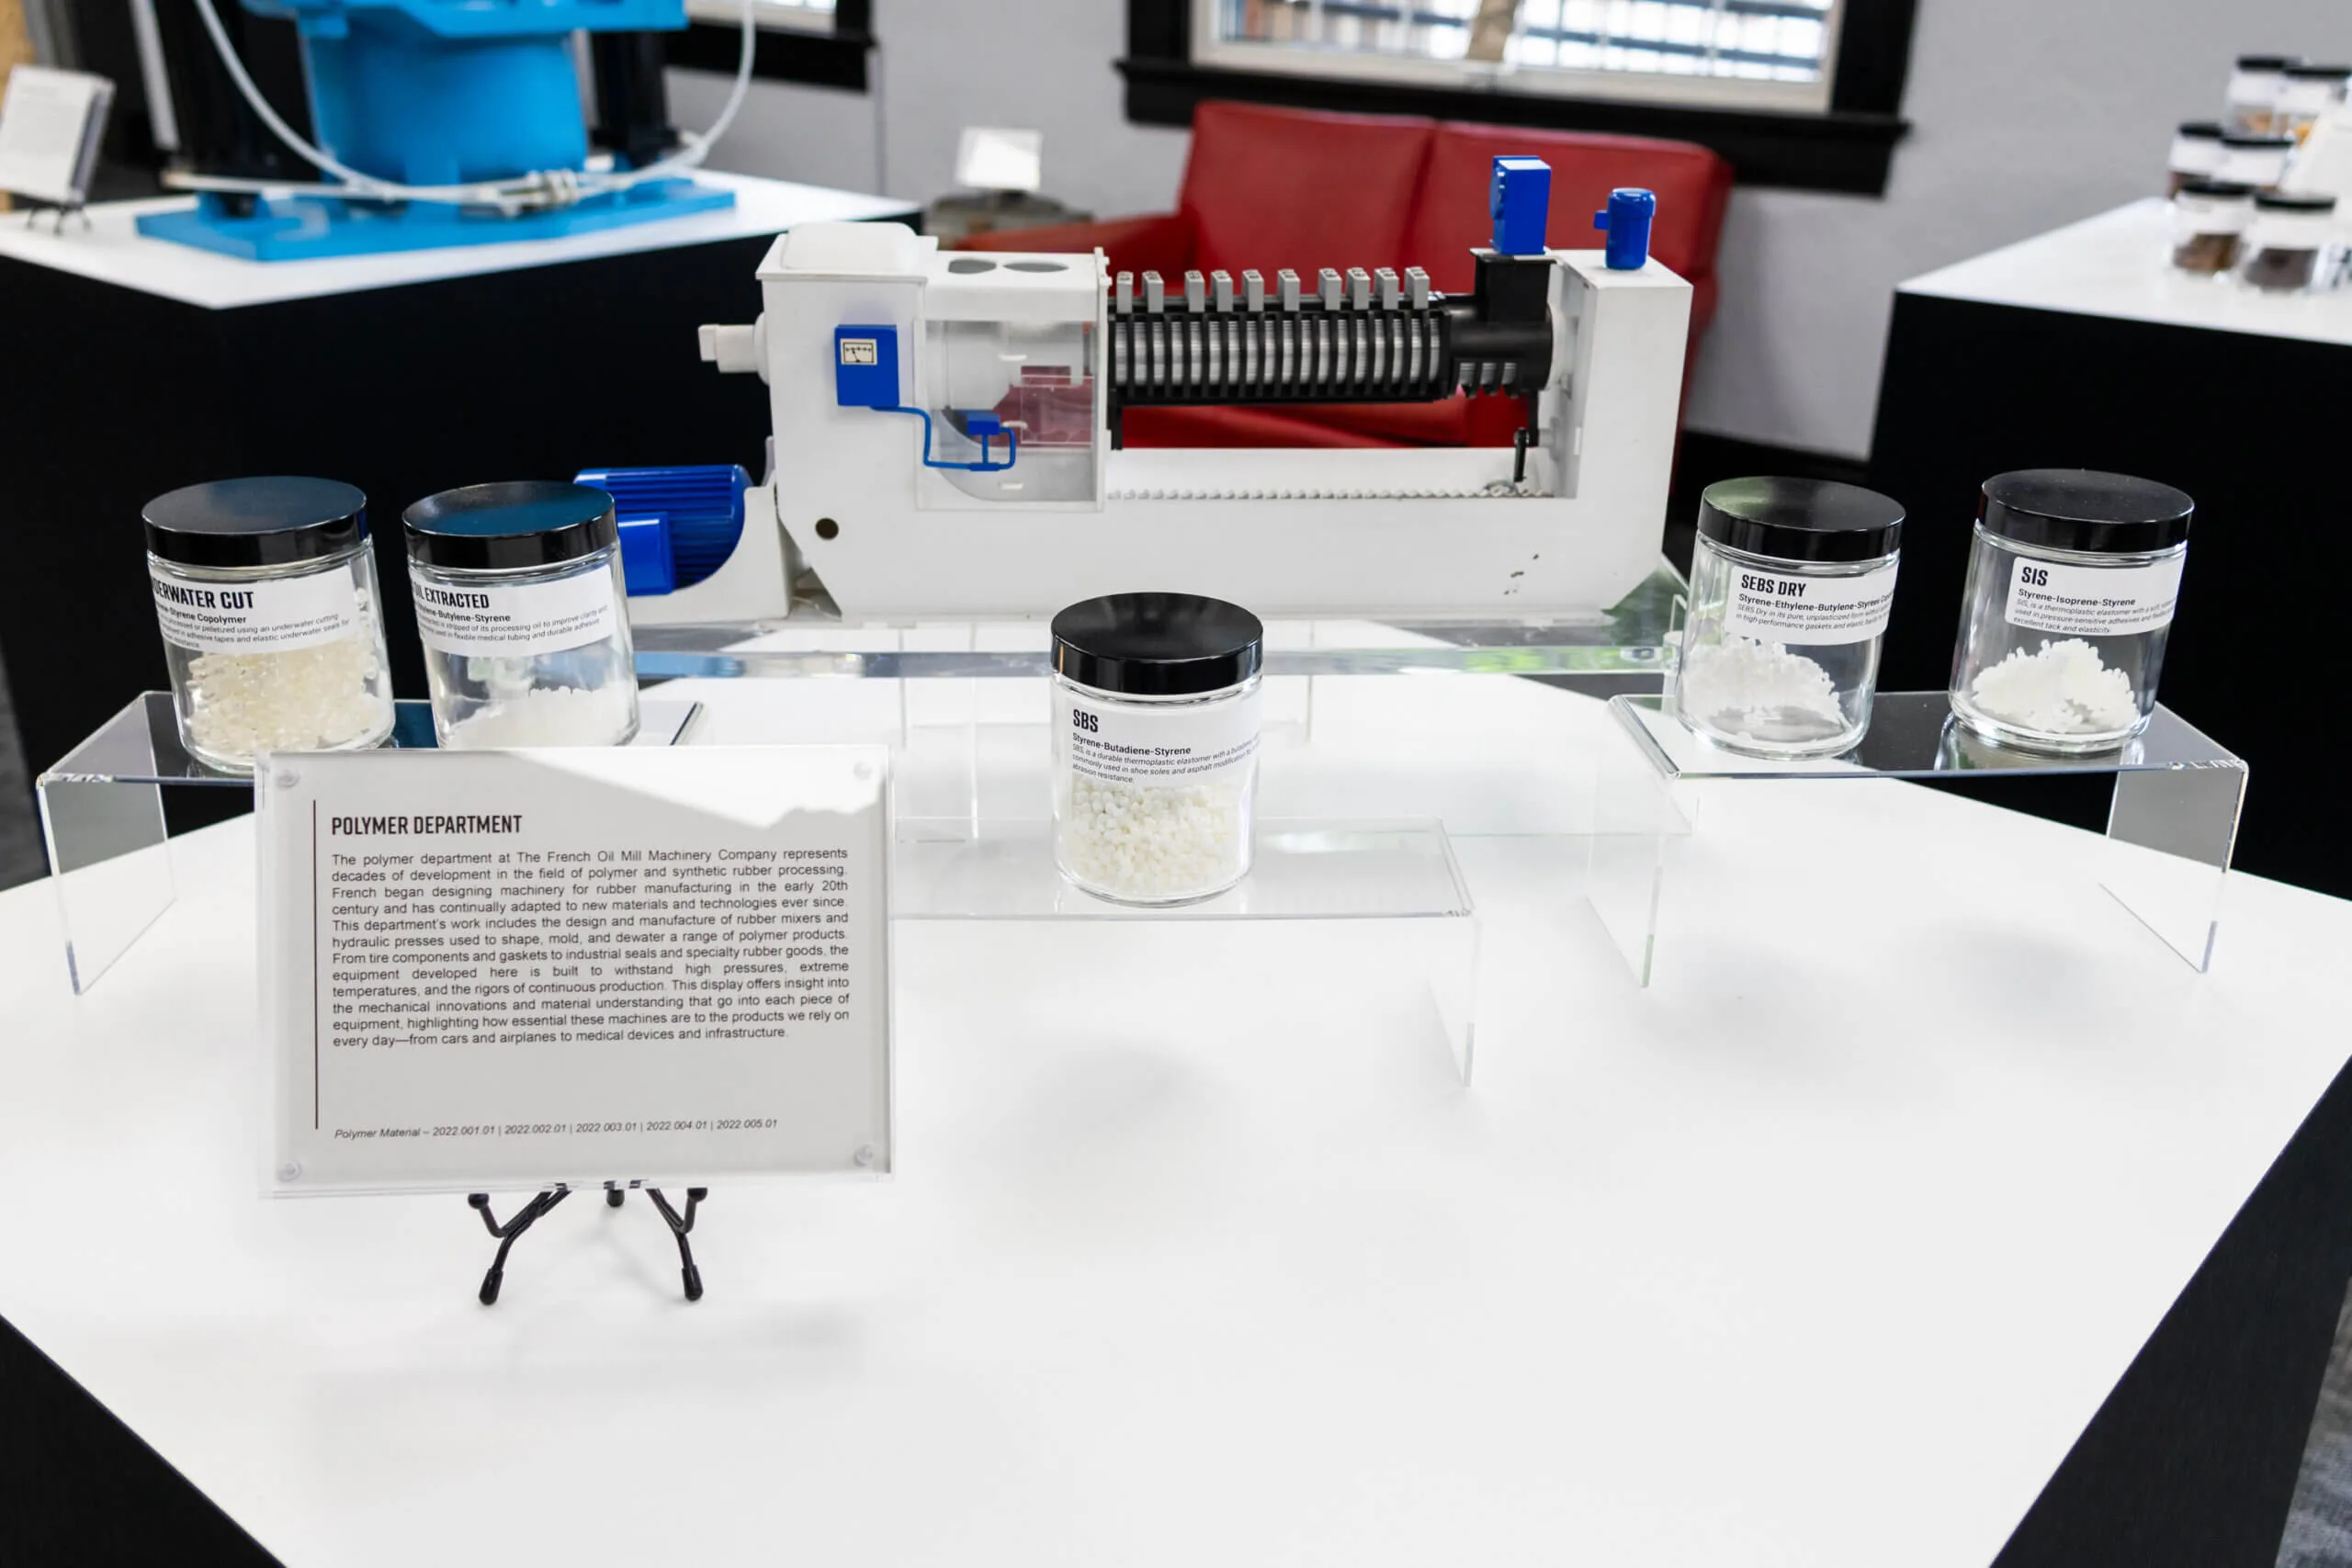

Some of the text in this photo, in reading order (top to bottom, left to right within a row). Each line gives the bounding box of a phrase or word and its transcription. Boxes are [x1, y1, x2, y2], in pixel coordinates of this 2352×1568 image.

[1742, 574, 1806, 597] SEBS DRY
[2021, 566, 2049, 587] SIS
[220, 592, 254, 609] CUT
[426, 587, 490, 608] EXTRACTED
[2018, 588, 2136, 607] Styrene-Isoprene-Styrene
[198, 613, 246, 625] Copolymer
[271, 619, 314, 632] underwater
[491, 624, 531, 633] processing
[507, 633, 530, 641] tubing
[1073, 709, 1098, 733] SBS
[1073, 732, 1192, 757] Styrene-Butadiene-Styrene
[1073, 754, 1102, 770] commonly
[1103, 764, 1120, 773] used
[1150, 768, 1170, 776] soles
[1171, 767, 1186, 775] and
[1186, 763, 1212, 773] asphalt
[1097, 752, 1123, 762] durable
[1124, 757, 1175, 766] thermoplastic
[1177, 755, 1212, 765] elastomer
[332, 816, 522, 835] POLYMER DEPARTMENT
[332, 849, 848, 867] The polymer department at The French Oil Mill Machinery Company represents
[332, 871, 386, 882] decades
[391, 870, 404, 881] of
[410, 869, 491, 882] development
[497, 871, 507, 879] in
[514, 869, 533, 879] the
[539, 868, 565, 878] field
[571, 867, 582, 878] of
[588, 867, 638, 880] polymer
[644, 867, 666, 877] and
[673, 866, 727, 879] synthetic
[733, 865, 772, 875] rubber
[333, 880, 848, 900] French began designing machinery for rubber manufacturing in the early 20th
[332, 904, 379, 917] century
[384, 904, 407, 914] and
[413, 903, 435, 913] has
[439, 902, 506, 915] continually
[511, 901, 560, 913] adapted
[566, 901, 578, 911] to
[582, 902, 607, 910] new
[612, 899, 668, 910] materials
[673, 898, 695, 909] and
[700, 897, 777, 910] technologies
[782, 899, 808, 908] ever
[332, 919, 359, 931] This
[451, 919, 481, 929] work
[486, 918, 537, 929] includes
[542, 917, 560, 928] the
[566, 917, 606, 930] design
[611, 916, 634, 926] and
[639, 915, 716, 926] manufacture
[720, 914, 732, 925] of
[737, 914, 776, 924] rubber
[781, 914, 821, 923] mixers
[826, 911, 848, 923] and
[333, 936, 390, 950] hydraulic
[395, 937, 444, 949] presses
[449, 935, 480, 946] used
[485, 935, 496, 945] to
[588, 932, 610, 943] and
[616, 933, 665, 942] dewater
[670, 933, 677, 942] a
[683, 933, 718, 944] range
[722, 931, 734, 941] of
[740, 931, 787, 942] polymer
[333, 953, 366, 964] From
[369, 953, 390, 963] tire
[392, 952, 469, 964] components
[472, 951, 496, 962] and
[500, 950, 548, 964] gaskets
[551, 950, 563, 960] to
[566, 948, 621, 959] industrial
[625, 948, 657, 959] seals
[660, 948, 683, 958] and
[686, 947, 740, 960] specialty
[743, 946, 783, 956] rubber
[830, 944, 849, 955] the
[334, 1128, 378, 1141] Polymer
[379, 1128, 421, 1138] Material
